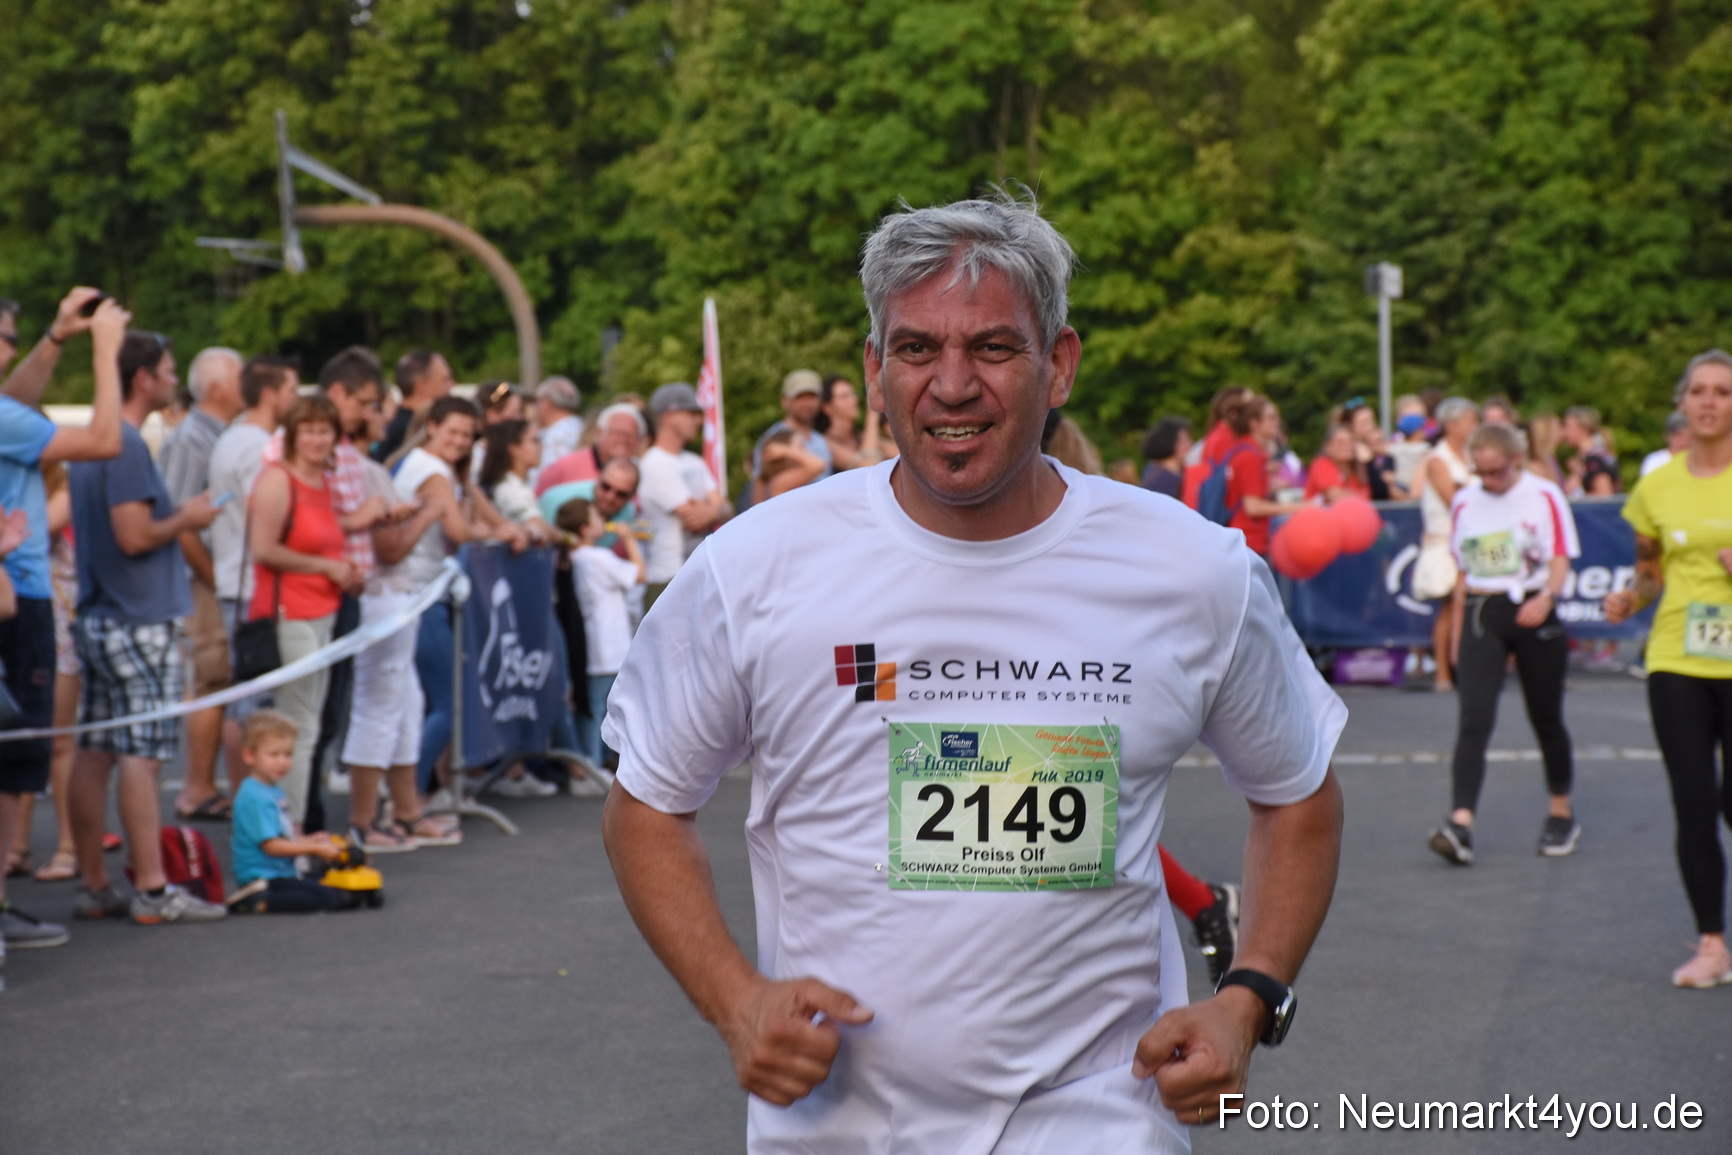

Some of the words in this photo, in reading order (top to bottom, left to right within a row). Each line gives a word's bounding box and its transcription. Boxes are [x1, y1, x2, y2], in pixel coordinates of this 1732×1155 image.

[909, 660, 1133, 684] SCHWARZ
[909, 690, 1027, 701] COMPUTER
[1037, 691, 1133, 705] SYSTEME
[923, 754, 1012, 772] firmenlauf
[1031, 770, 1058, 784] run
[1064, 769, 1104, 783] 2019
[915, 784, 1087, 844] 2149
[962, 846, 1015, 862] Preiss
[1020, 846, 1046, 862] Olf
[901, 862, 960, 874] SCHWARZ
[962, 863, 1017, 877] Computer
[1020, 864, 1066, 877] Systeme
[1069, 862, 1102, 872] GmbH
